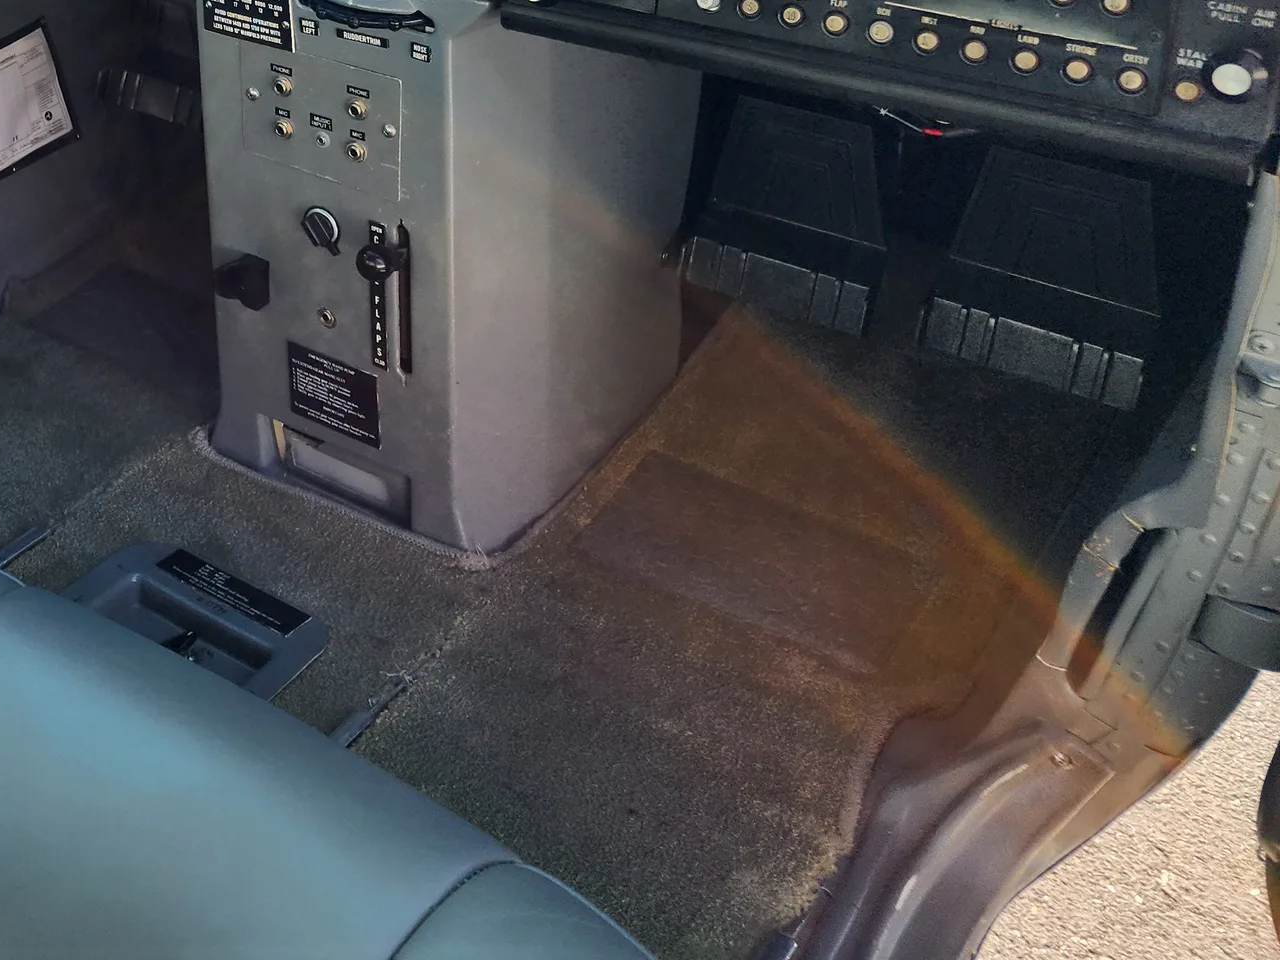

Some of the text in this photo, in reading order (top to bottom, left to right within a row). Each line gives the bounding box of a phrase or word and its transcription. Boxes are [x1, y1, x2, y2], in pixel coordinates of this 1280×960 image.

[301, 26, 317, 36] LEFT
[343, 30, 382, 47] RUDDERTRIM
[412, 43, 429, 54] NOSE
[1065, 43, 1098, 56] STROBE
[412, 51, 429, 62] RIGHT
[272, 65, 291, 75] PHONE
[348, 86, 369, 98] PHONE
[278, 108, 289, 117] MIC
[311, 120, 328, 130] INPUT
[313, 115, 332, 125] MUSIC
[351, 130, 363, 140] MIC
[370, 225, 384, 235] OPEN
[374, 295, 383, 357] FLAPS
